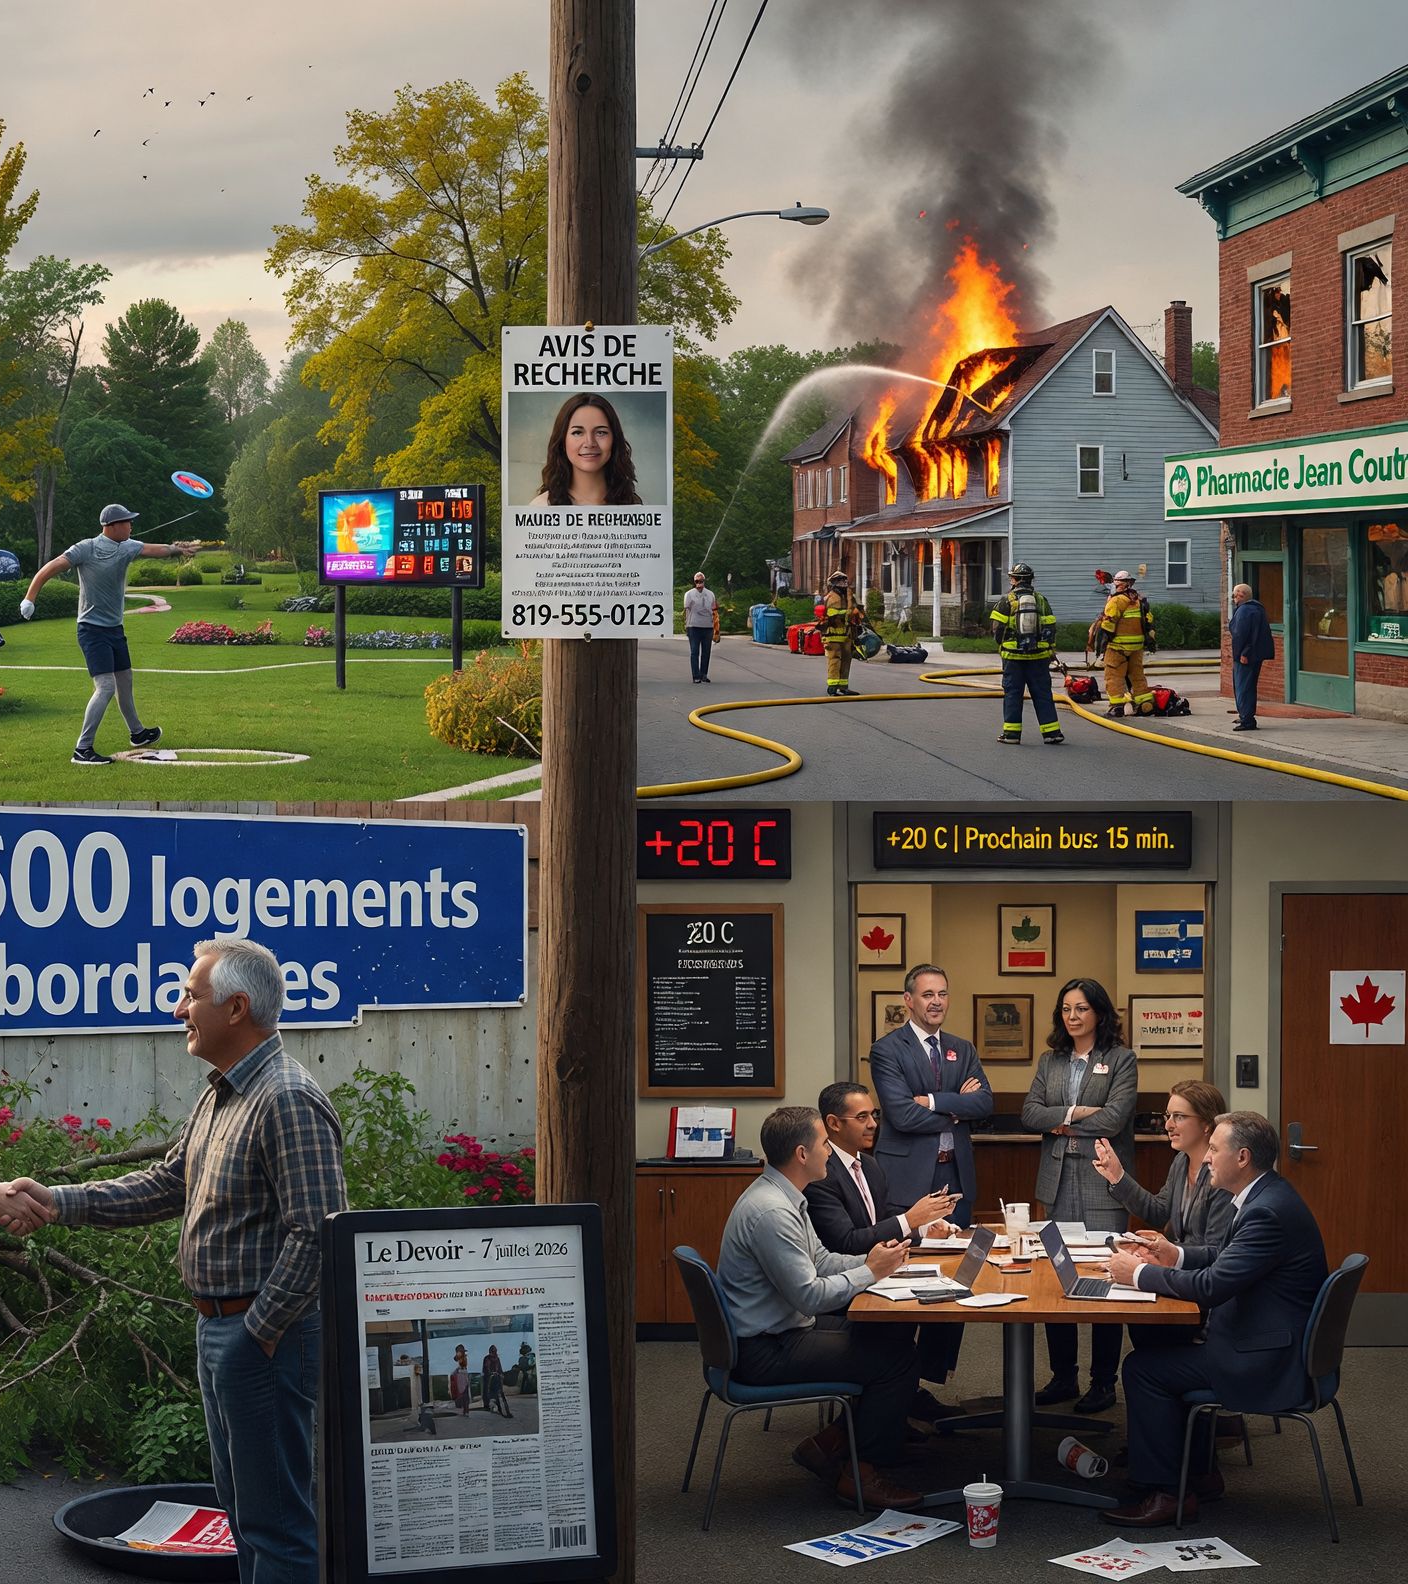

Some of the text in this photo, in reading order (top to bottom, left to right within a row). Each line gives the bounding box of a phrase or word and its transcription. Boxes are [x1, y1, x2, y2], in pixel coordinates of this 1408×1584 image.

[538, 334, 636, 357] AVIS DE
[514, 362, 662, 386] RECHERCHE
[1196, 458, 1289, 497] Pharmacie
[1294, 454, 1342, 490] Jean
[566, 513, 583, 526] DE
[512, 603, 665, 626] 819-555-0123
[645, 820, 777, 866] +20 C
[887, 827, 927, 849] +20
[934, 827, 947, 849] C
[965, 826, 1052, 849] Prochain
[1059, 826, 1098, 849] bus:
[1106, 827, 1129, 849] 15
[1136, 827, 1175, 849] min.
[151, 855, 479, 940] logements
[720, 921, 734, 944] C
[364, 1241, 392, 1263] Le
[395, 1239, 464, 1262] Devoir
[481, 1238, 493, 1259] 7
[534, 1242, 568, 1256] 2026
